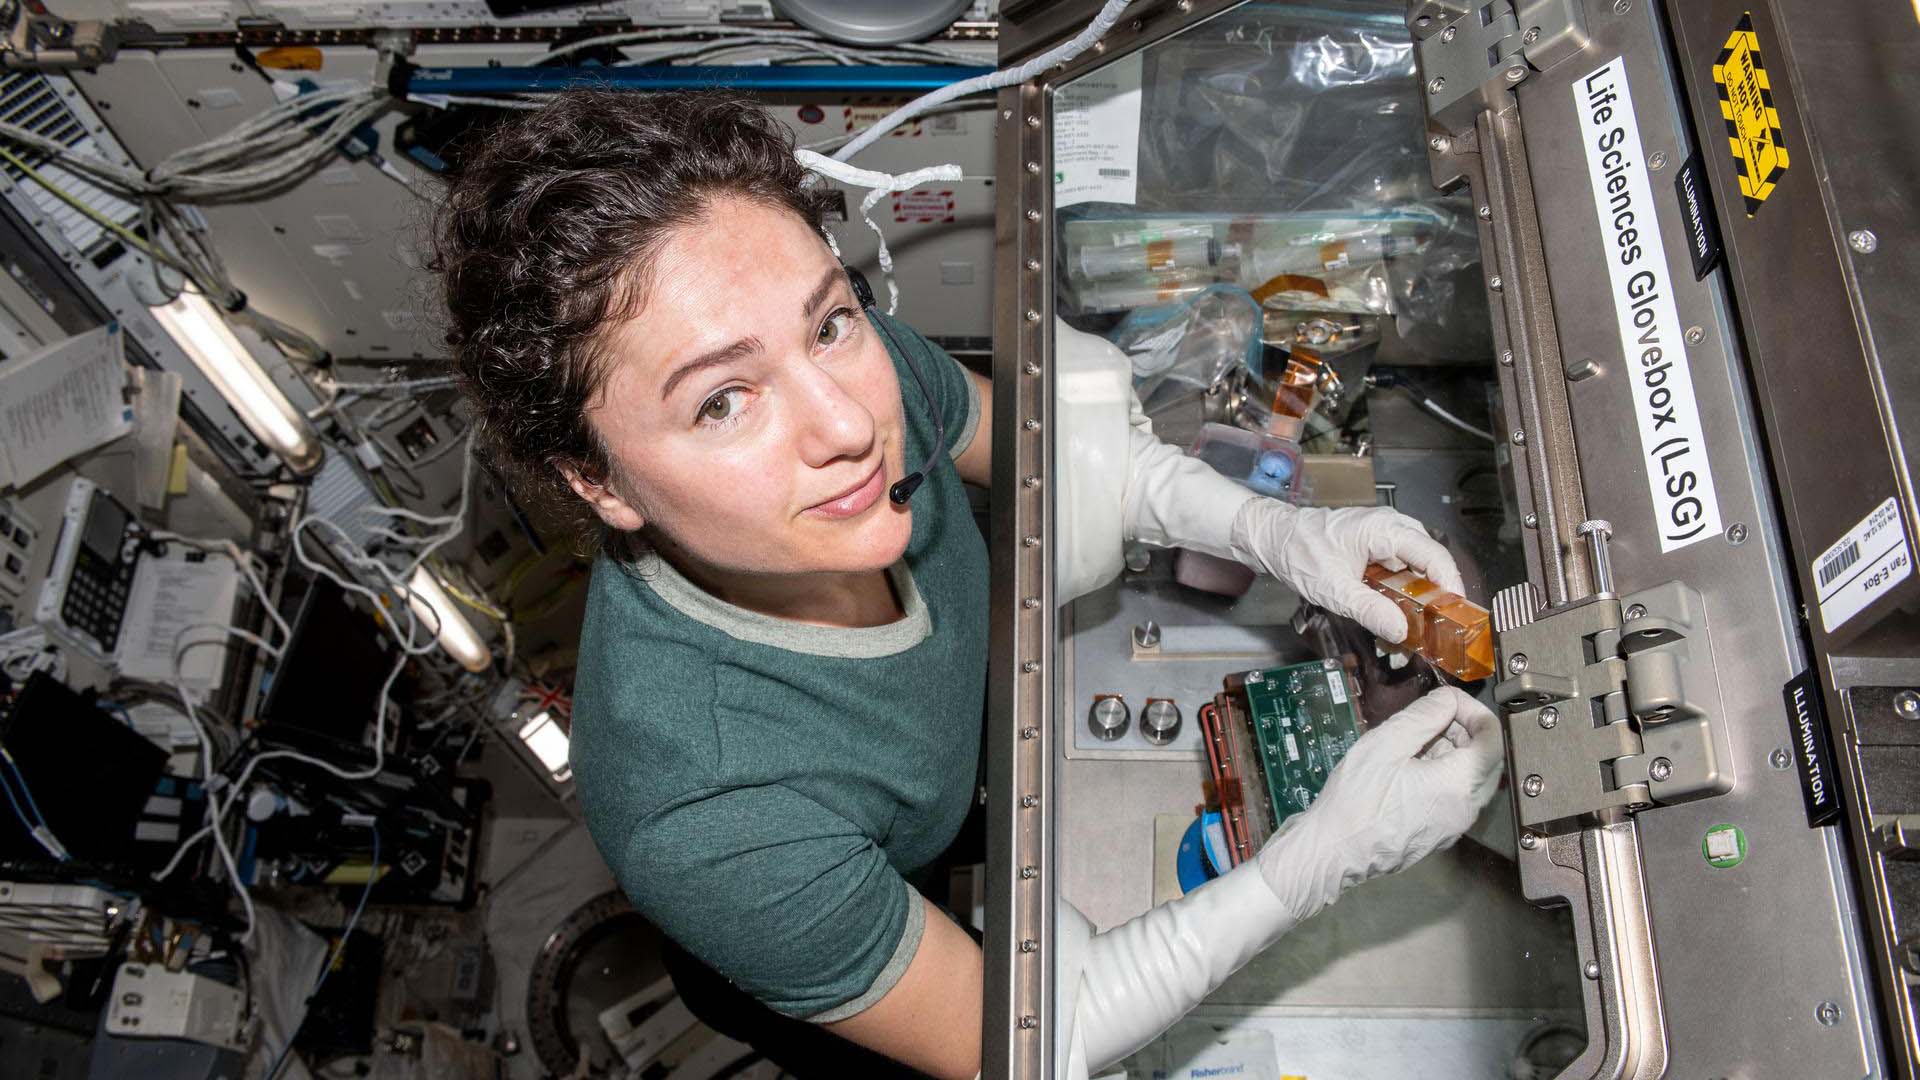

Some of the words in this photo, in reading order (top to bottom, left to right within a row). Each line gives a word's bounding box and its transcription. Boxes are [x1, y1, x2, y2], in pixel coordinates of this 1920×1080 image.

[1585, 66, 1617, 125] Life
[1737, 79, 1750, 112] HOT
[1740, 49, 1763, 122] WARNING
[1736, 108, 1747, 142] TOUCH
[1598, 126, 1642, 266] Sciences
[1682, 167, 1708, 258] ILLUMINATION
[1626, 270, 1677, 431] Glovebox
[1650, 437, 1706, 541] (LSG)
[1863, 567, 1890, 592] E-Box
[1890, 552, 1907, 571] Fan
[1793, 686, 1825, 805] ILLUMINATION
